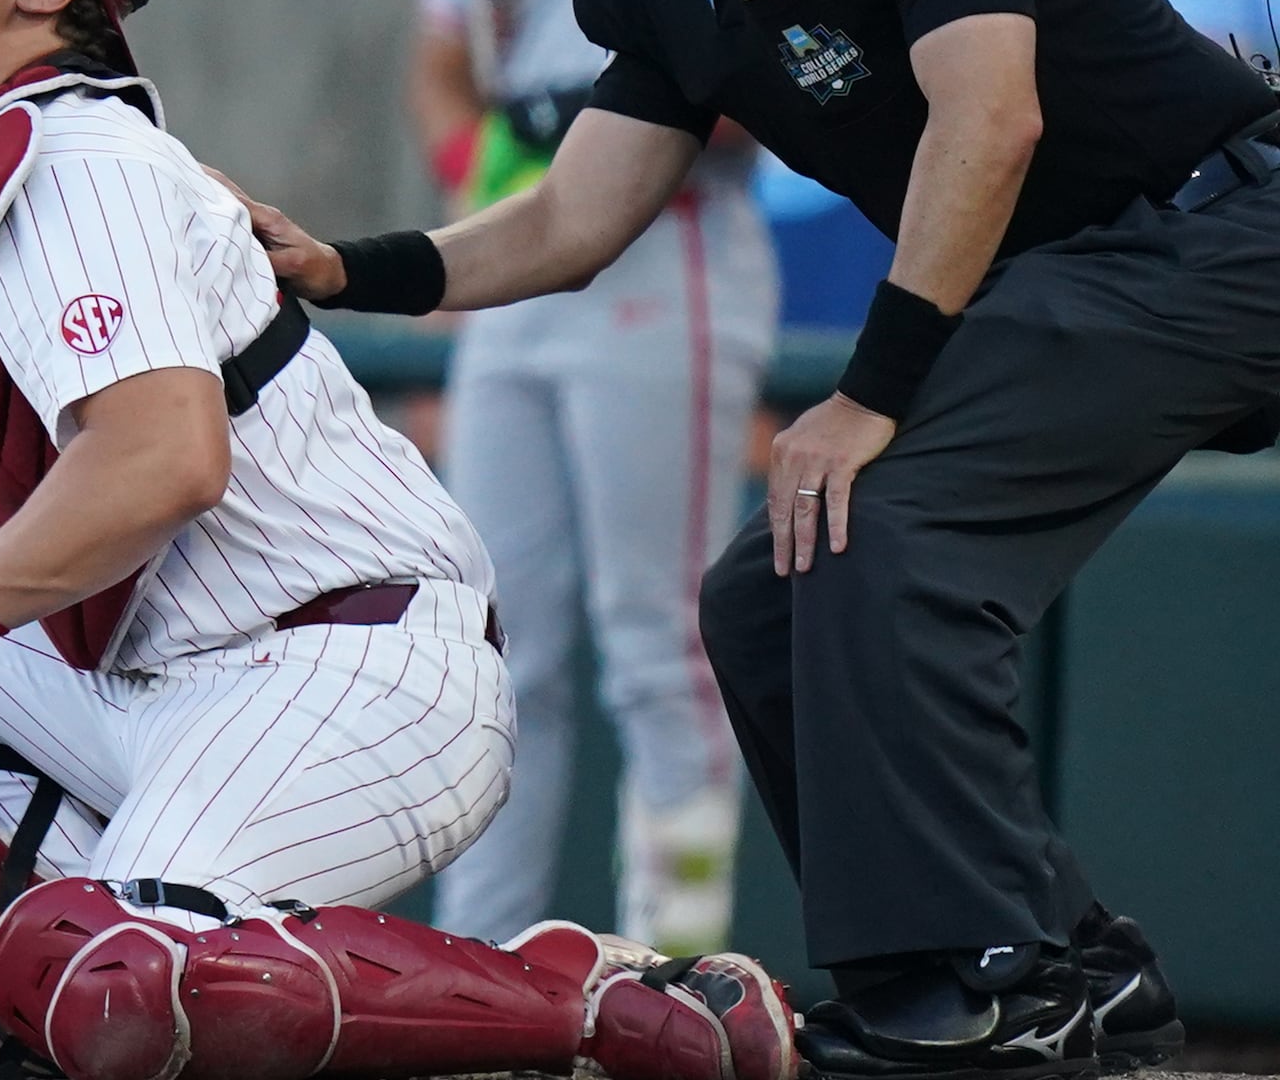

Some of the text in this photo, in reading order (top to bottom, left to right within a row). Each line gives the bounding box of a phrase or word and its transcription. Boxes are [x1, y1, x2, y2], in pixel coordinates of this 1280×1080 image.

[797, 66, 828, 87] WORLD
[825, 47, 859, 75] SERIES
[800, 47, 840, 73] COLLEGE
[63, 295, 123, 352] SEC
